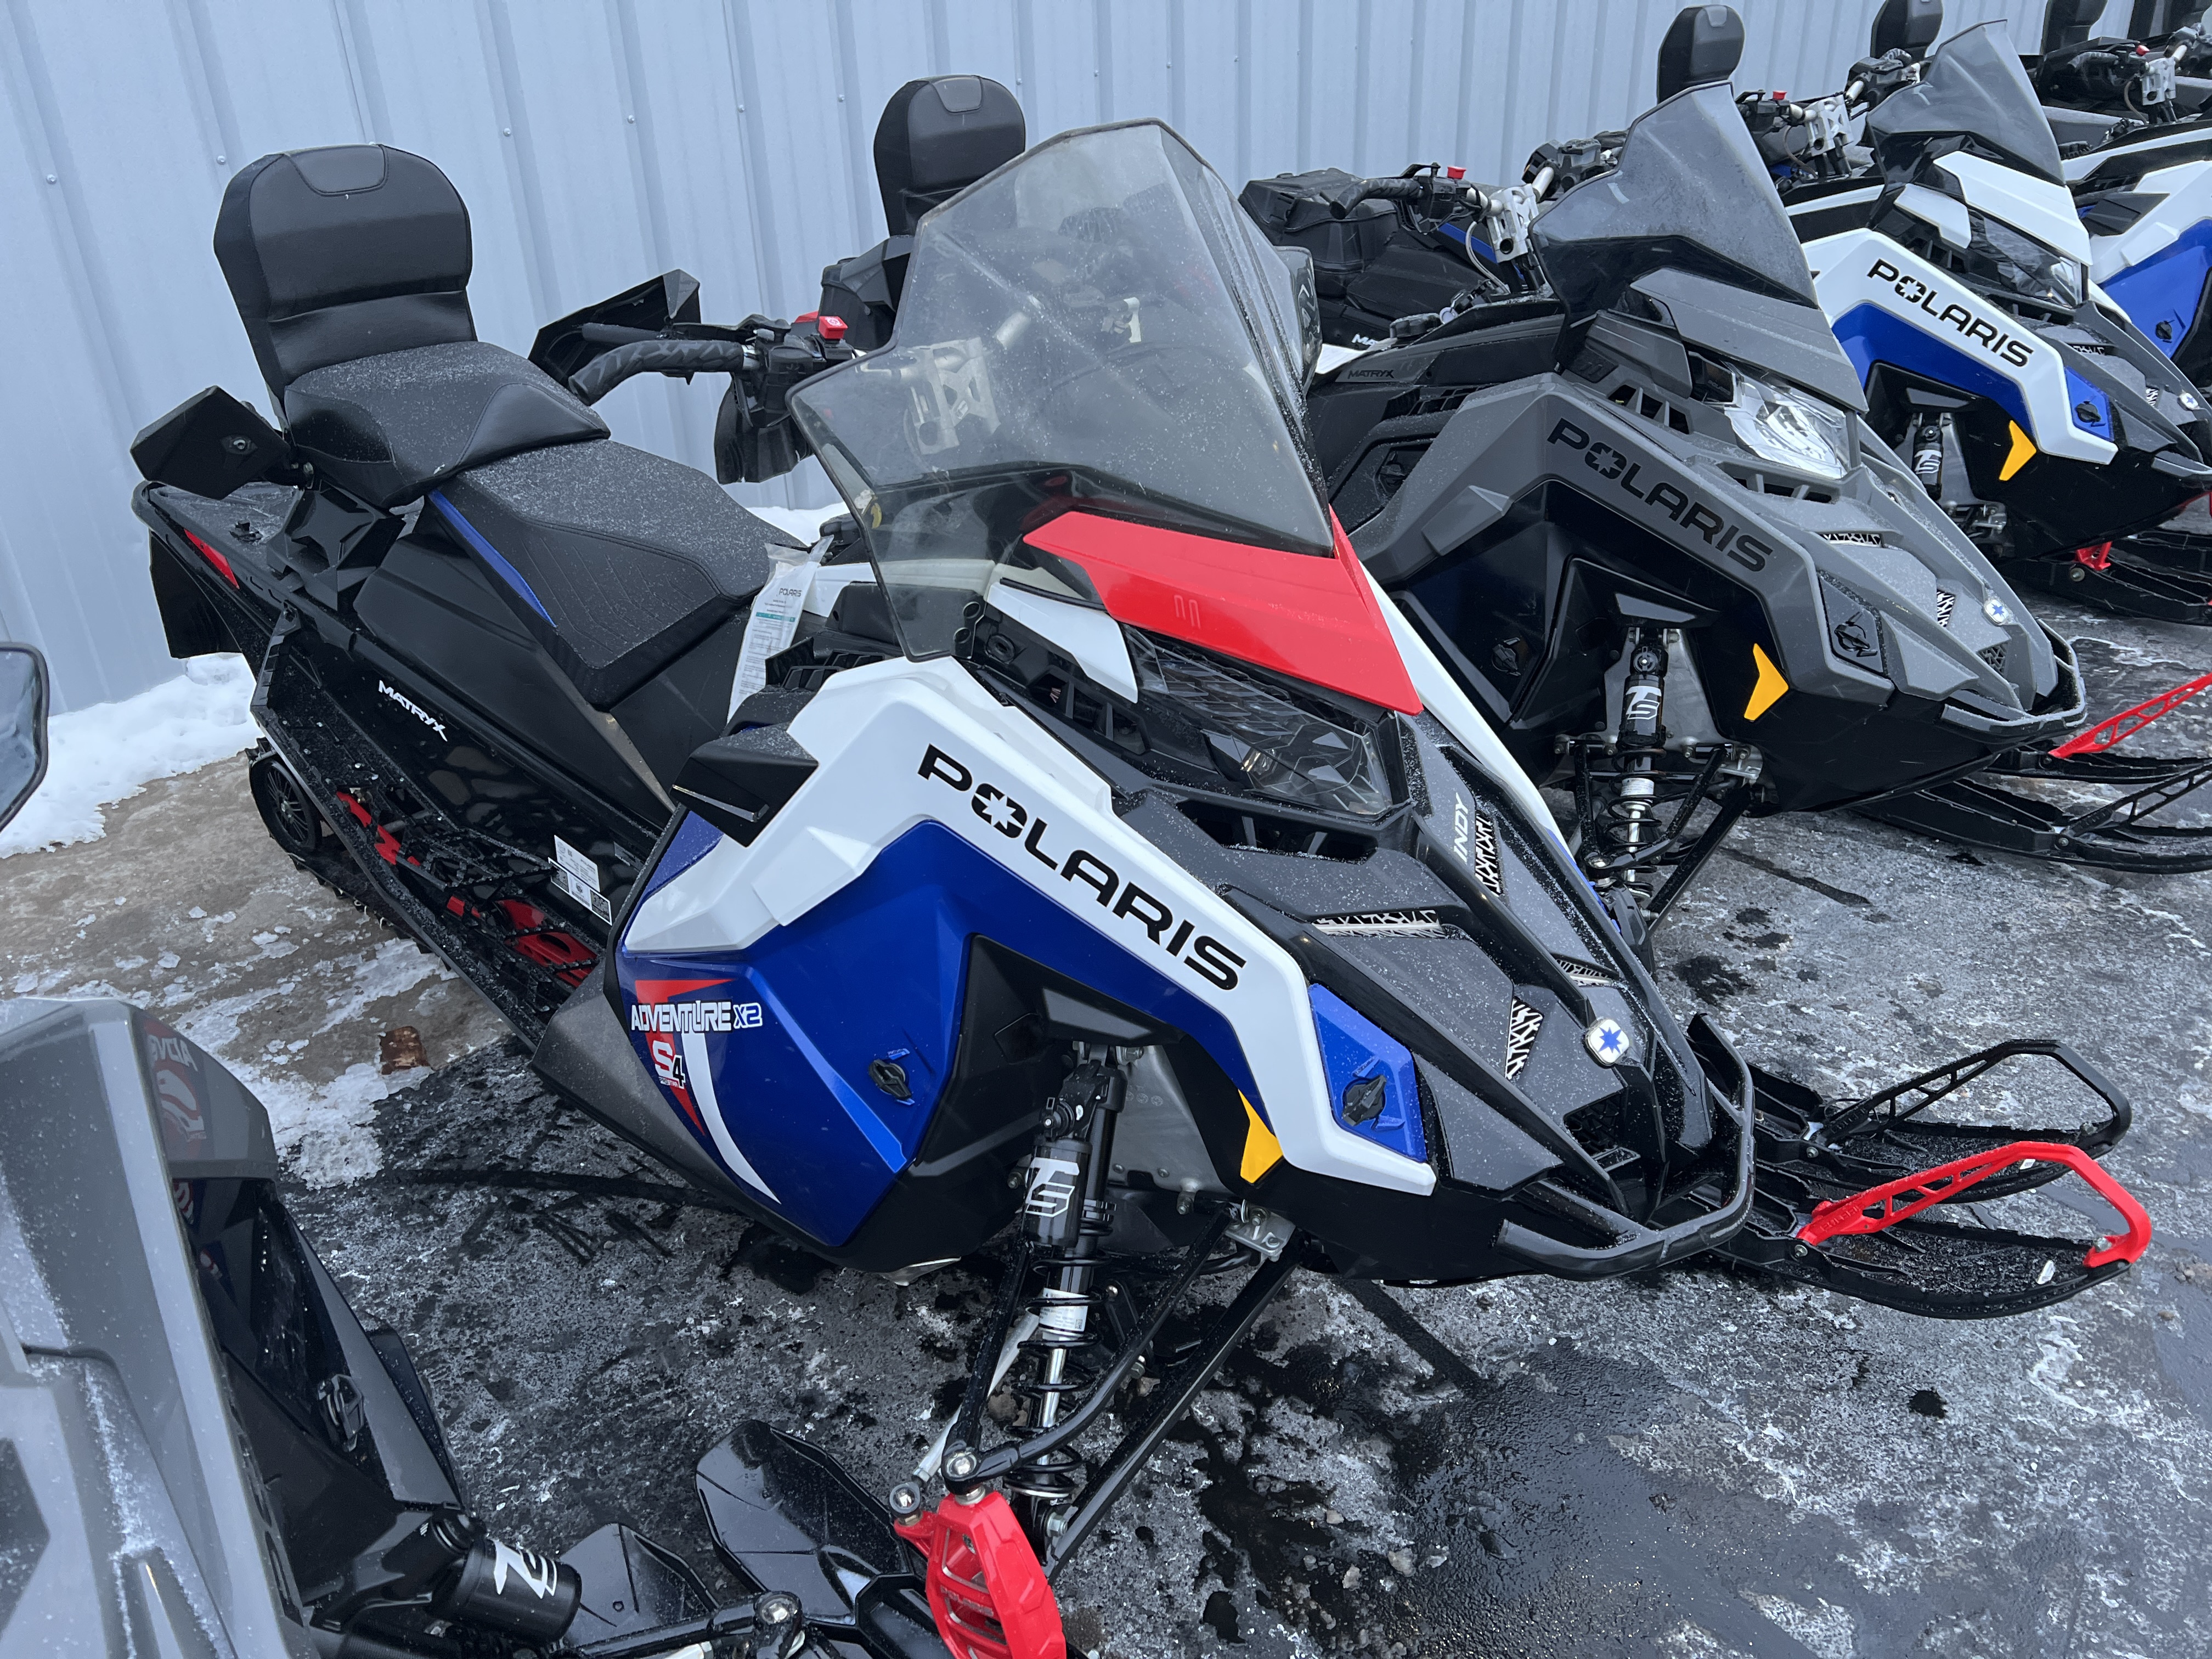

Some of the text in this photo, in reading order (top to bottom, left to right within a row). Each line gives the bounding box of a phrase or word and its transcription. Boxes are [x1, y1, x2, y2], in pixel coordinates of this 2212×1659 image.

[1867, 258, 2035, 368] POLARIS
[1347, 369, 1394, 380] MATRYX
[1547, 417, 1773, 573] POLARIS
[779, 588, 802, 597] POLARIS
[379, 680, 448, 742] MATRYX
[1454, 792, 1468, 863] INDY
[918, 743, 1248, 991] POLARIS
[631, 1000, 763, 1034] ADVENTURE X2
